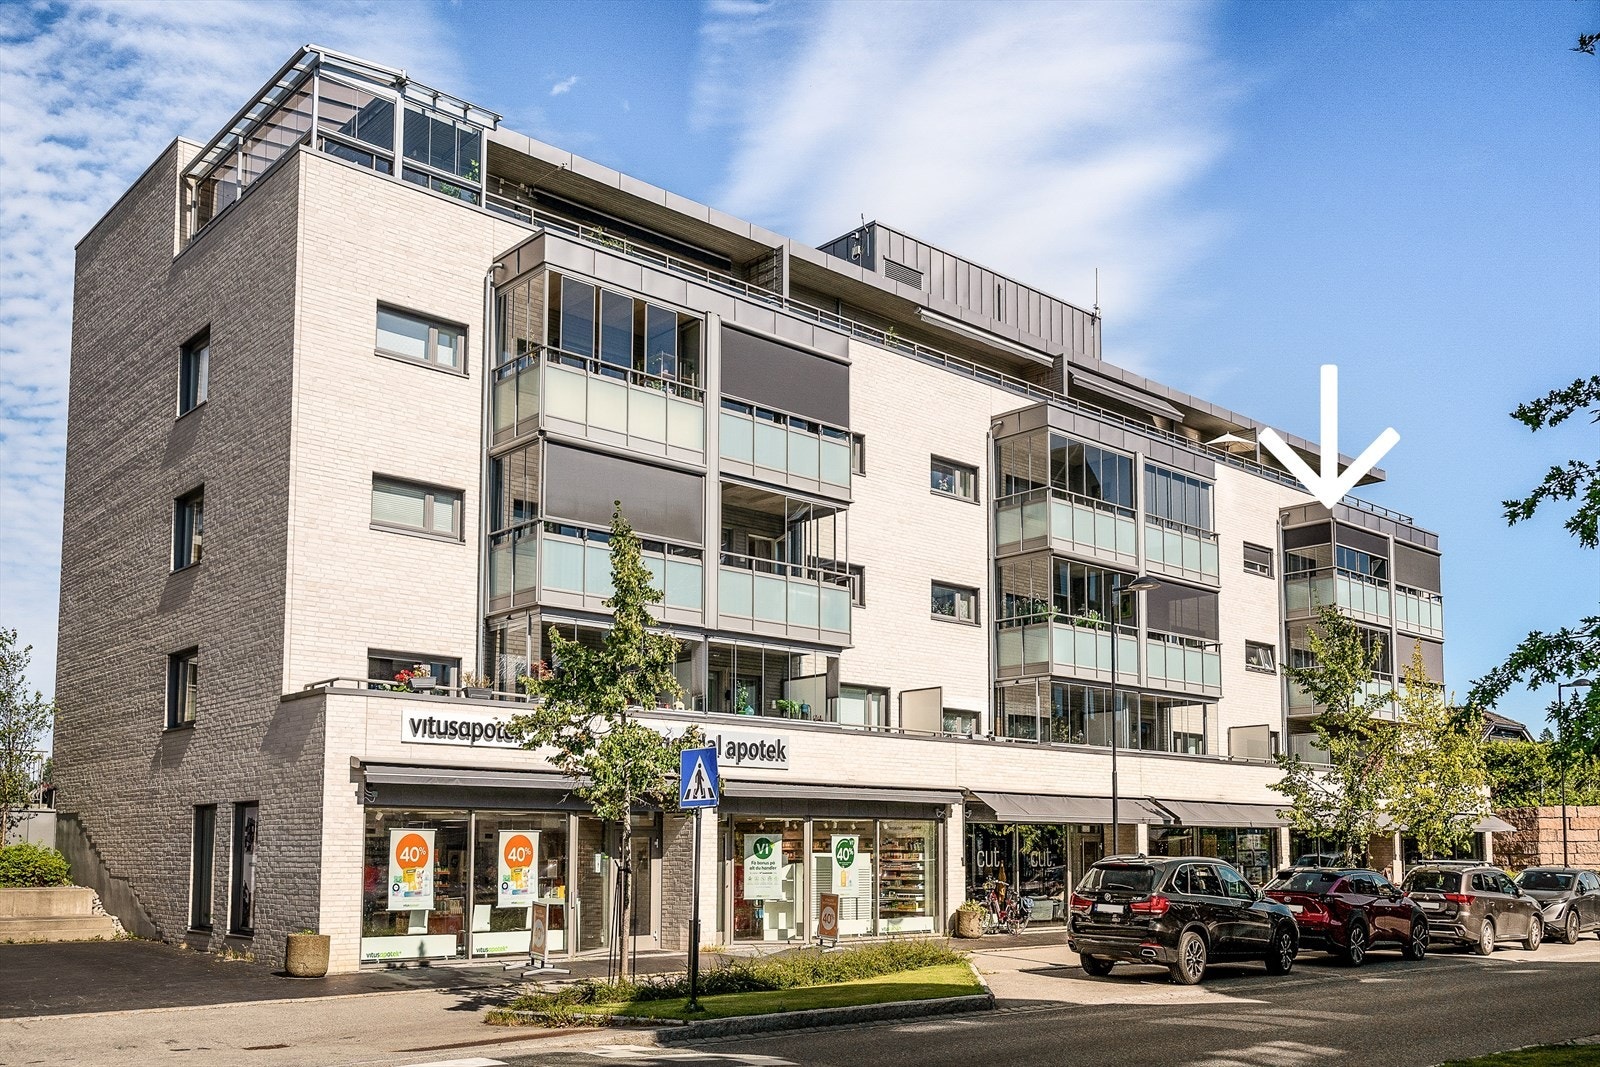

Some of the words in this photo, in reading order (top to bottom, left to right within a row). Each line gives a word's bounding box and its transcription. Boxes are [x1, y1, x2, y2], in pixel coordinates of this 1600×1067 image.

[409, 716, 524, 745] vitusapot
[725, 738, 786, 764] apotek
[400, 846, 426, 862] 40%
[508, 846, 531, 862] 40%
[837, 847, 854, 861] 40%
[1030, 847, 1056, 867] cut.
